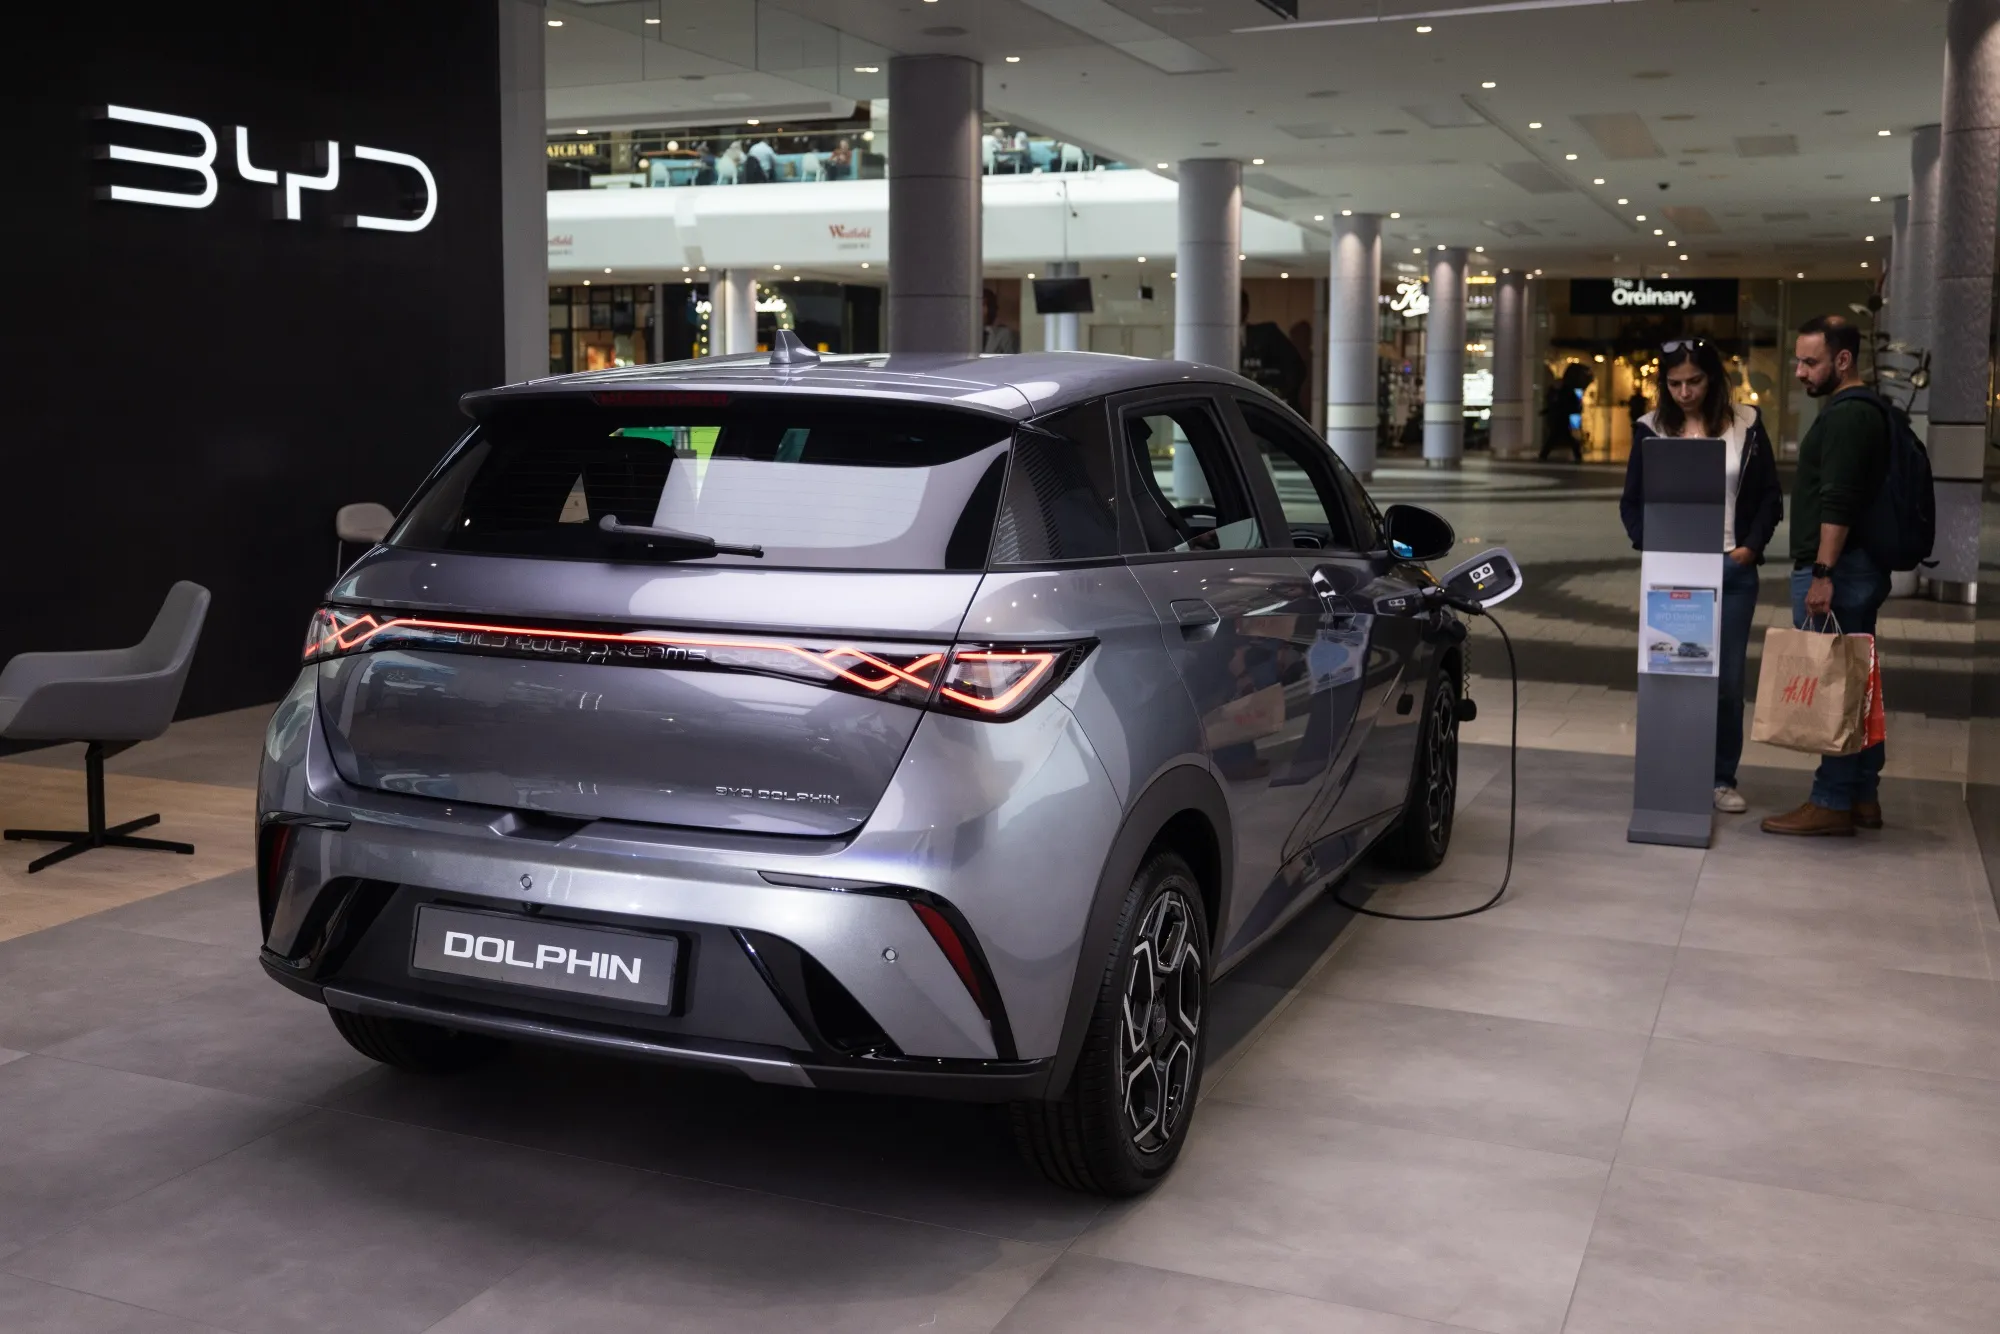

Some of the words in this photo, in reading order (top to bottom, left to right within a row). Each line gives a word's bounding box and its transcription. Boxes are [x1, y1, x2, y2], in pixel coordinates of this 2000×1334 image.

[108, 104, 438, 232] BYD
[1613, 277, 1633, 289] The
[515, 635, 584, 654] YOUR
[587, 643, 708, 664] DREAMS
[1781, 676, 1818, 708] H&M
[758, 789, 840, 804] DOLPHIN
[443, 930, 642, 984] DOLPHIN
